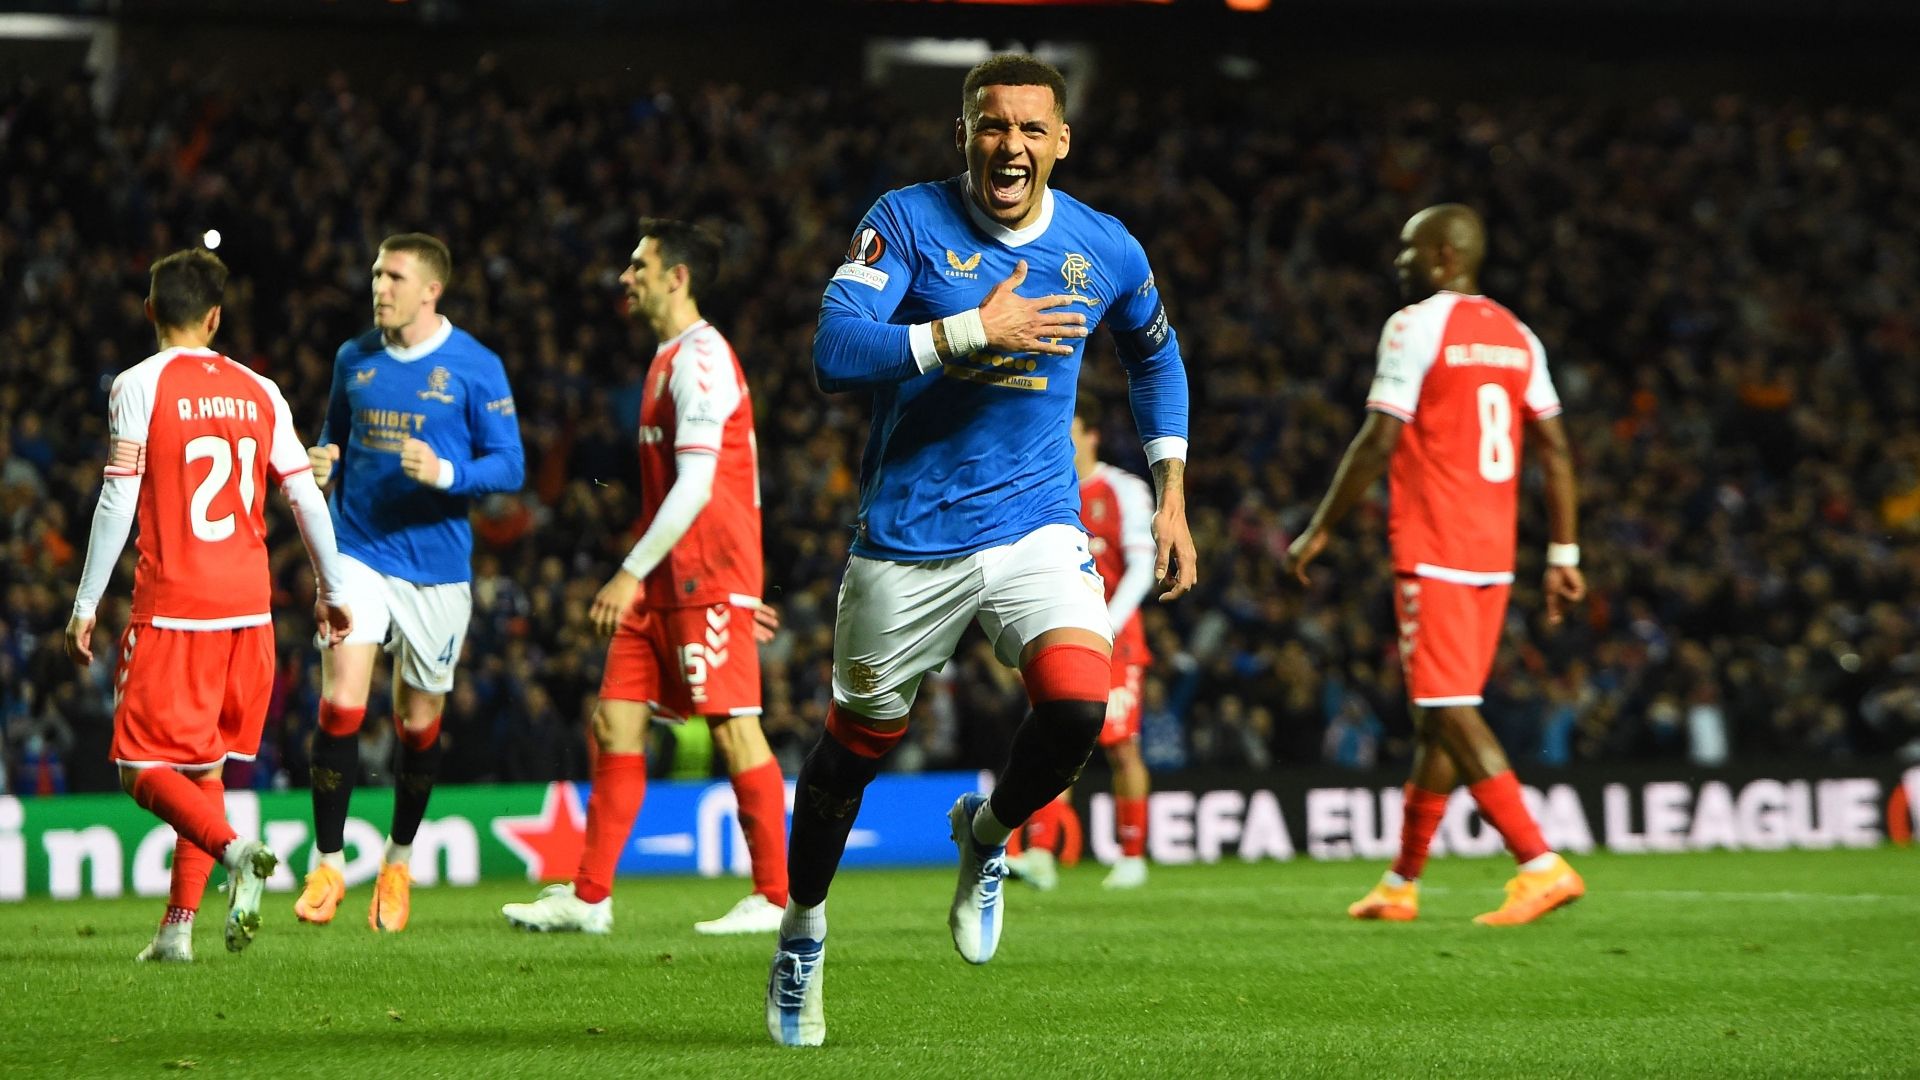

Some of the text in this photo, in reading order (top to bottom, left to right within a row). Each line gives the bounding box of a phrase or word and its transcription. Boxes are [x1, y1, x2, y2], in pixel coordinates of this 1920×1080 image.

[836, 264, 885, 284] OUNDATION
[1006, 376, 1033, 387] LIMITS
[1477, 383, 1516, 483] 8
[185, 435, 258, 542] 21
[437, 633, 454, 665] 4
[1306, 783, 1597, 858] EUOA
[1603, 778, 1881, 854] LEAGUE
